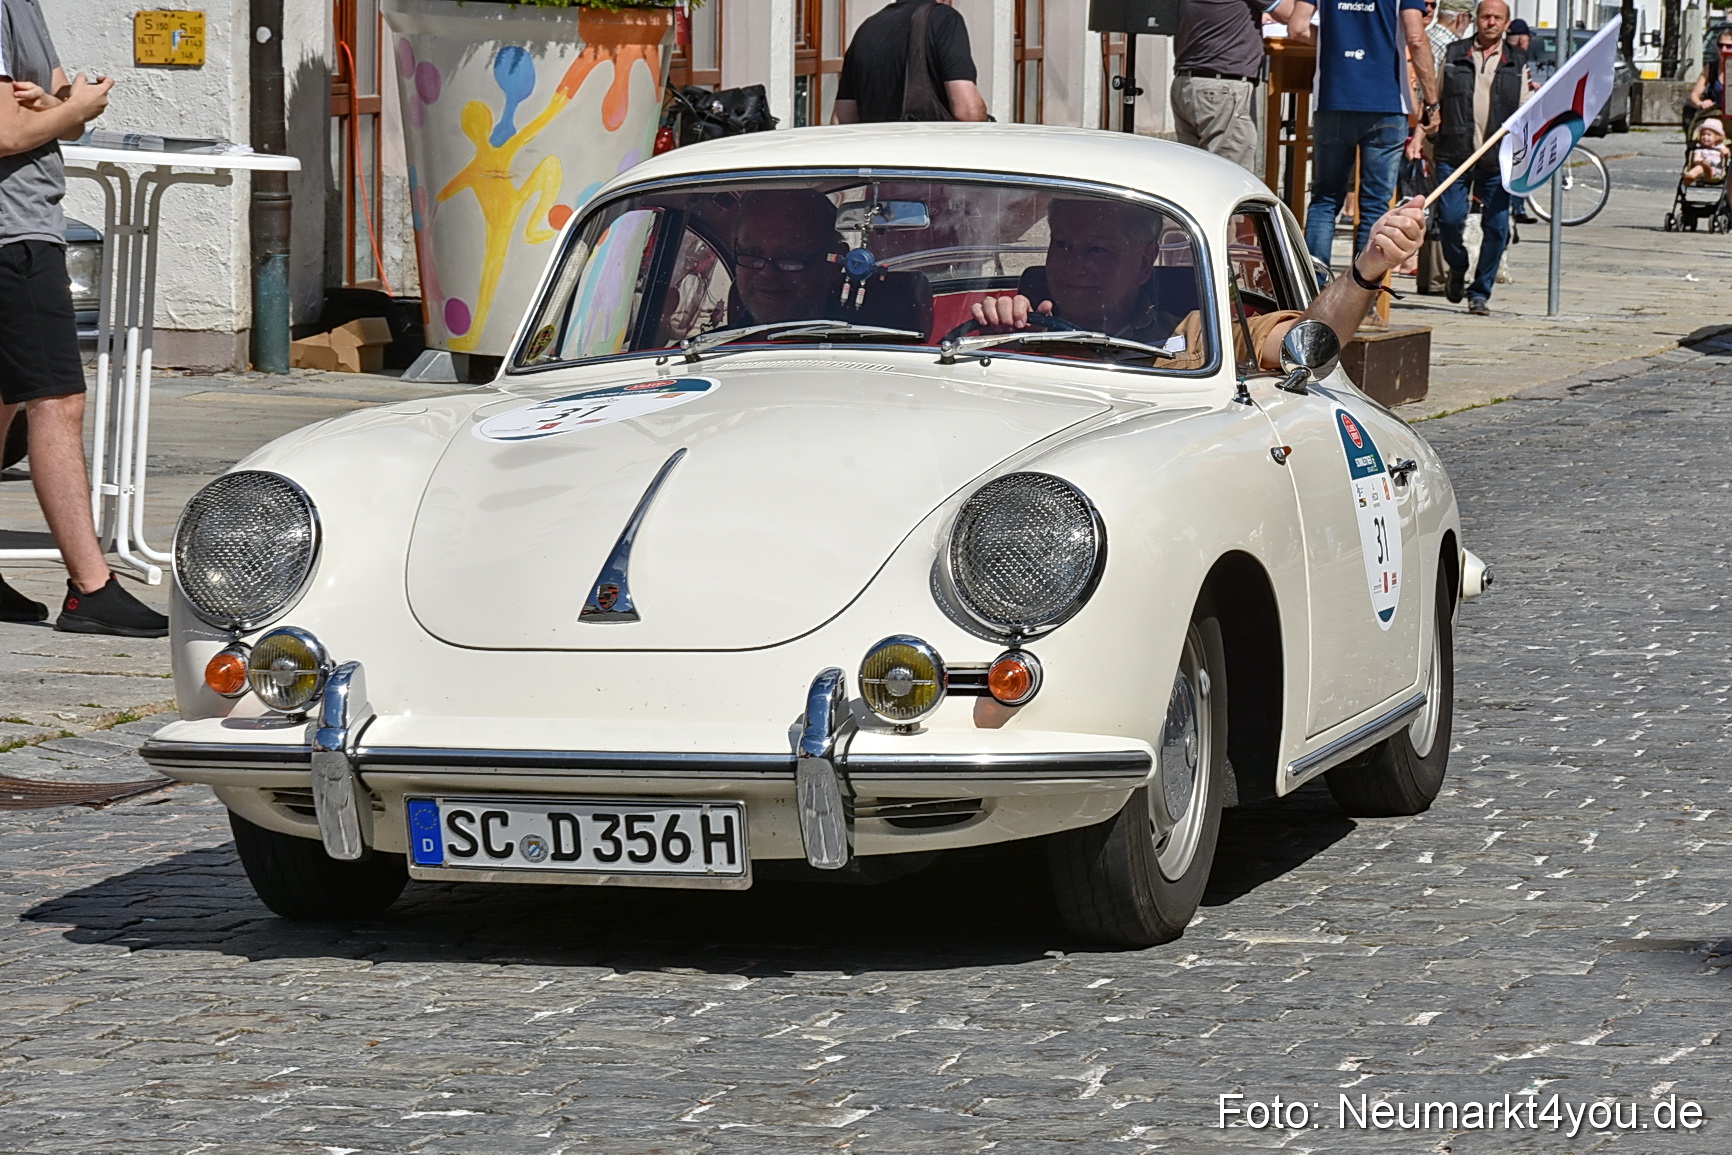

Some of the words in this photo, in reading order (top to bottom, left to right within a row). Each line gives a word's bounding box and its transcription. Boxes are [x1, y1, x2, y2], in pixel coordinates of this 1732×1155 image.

[1337, 1, 1376, 12] randstad
[145, 19, 152, 30] S
[537, 405, 608, 423] 31
[1374, 516, 1389, 565] 31
[446, 809, 515, 860] SC
[421, 838, 434, 853] D
